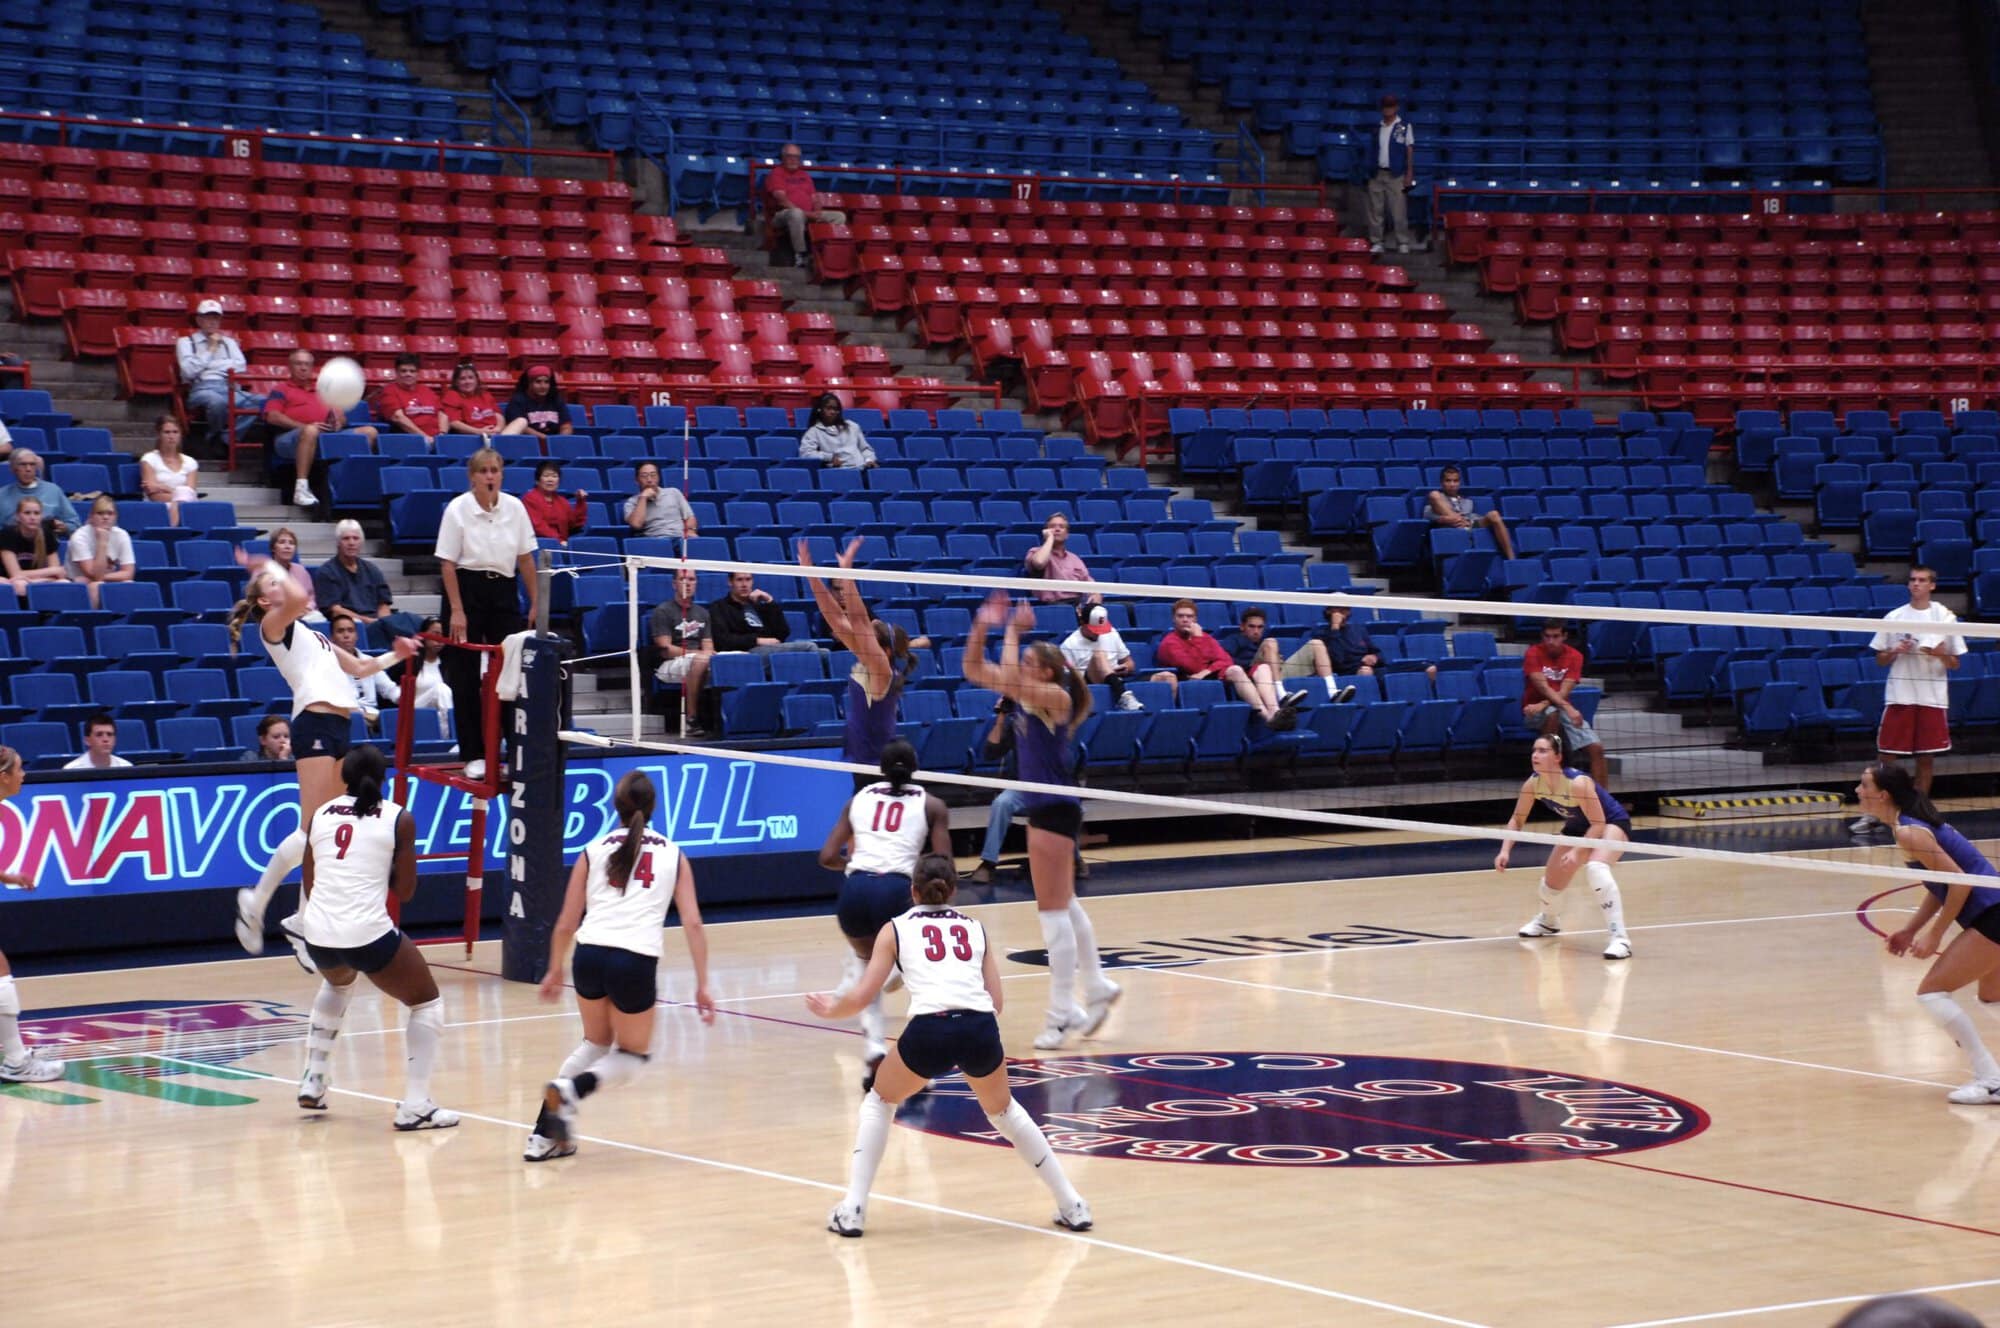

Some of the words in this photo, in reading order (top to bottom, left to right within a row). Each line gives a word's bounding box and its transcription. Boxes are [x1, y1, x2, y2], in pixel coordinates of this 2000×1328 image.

[232, 139, 250, 157] 16
[1018, 183, 1031, 200] 17
[1763, 198, 1779, 214] 18
[651, 391, 670, 407] 16
[1412, 399, 1426, 410] 17
[1951, 398, 1969, 414] 18
[872, 801, 904, 832] 10
[335, 823, 353, 860] 9
[922, 924, 973, 962] 33
[1041, 1079, 1465, 1128] OLSON
[1472, 1074, 1684, 1133] LUTE
[1456, 1132, 1619, 1151] &
